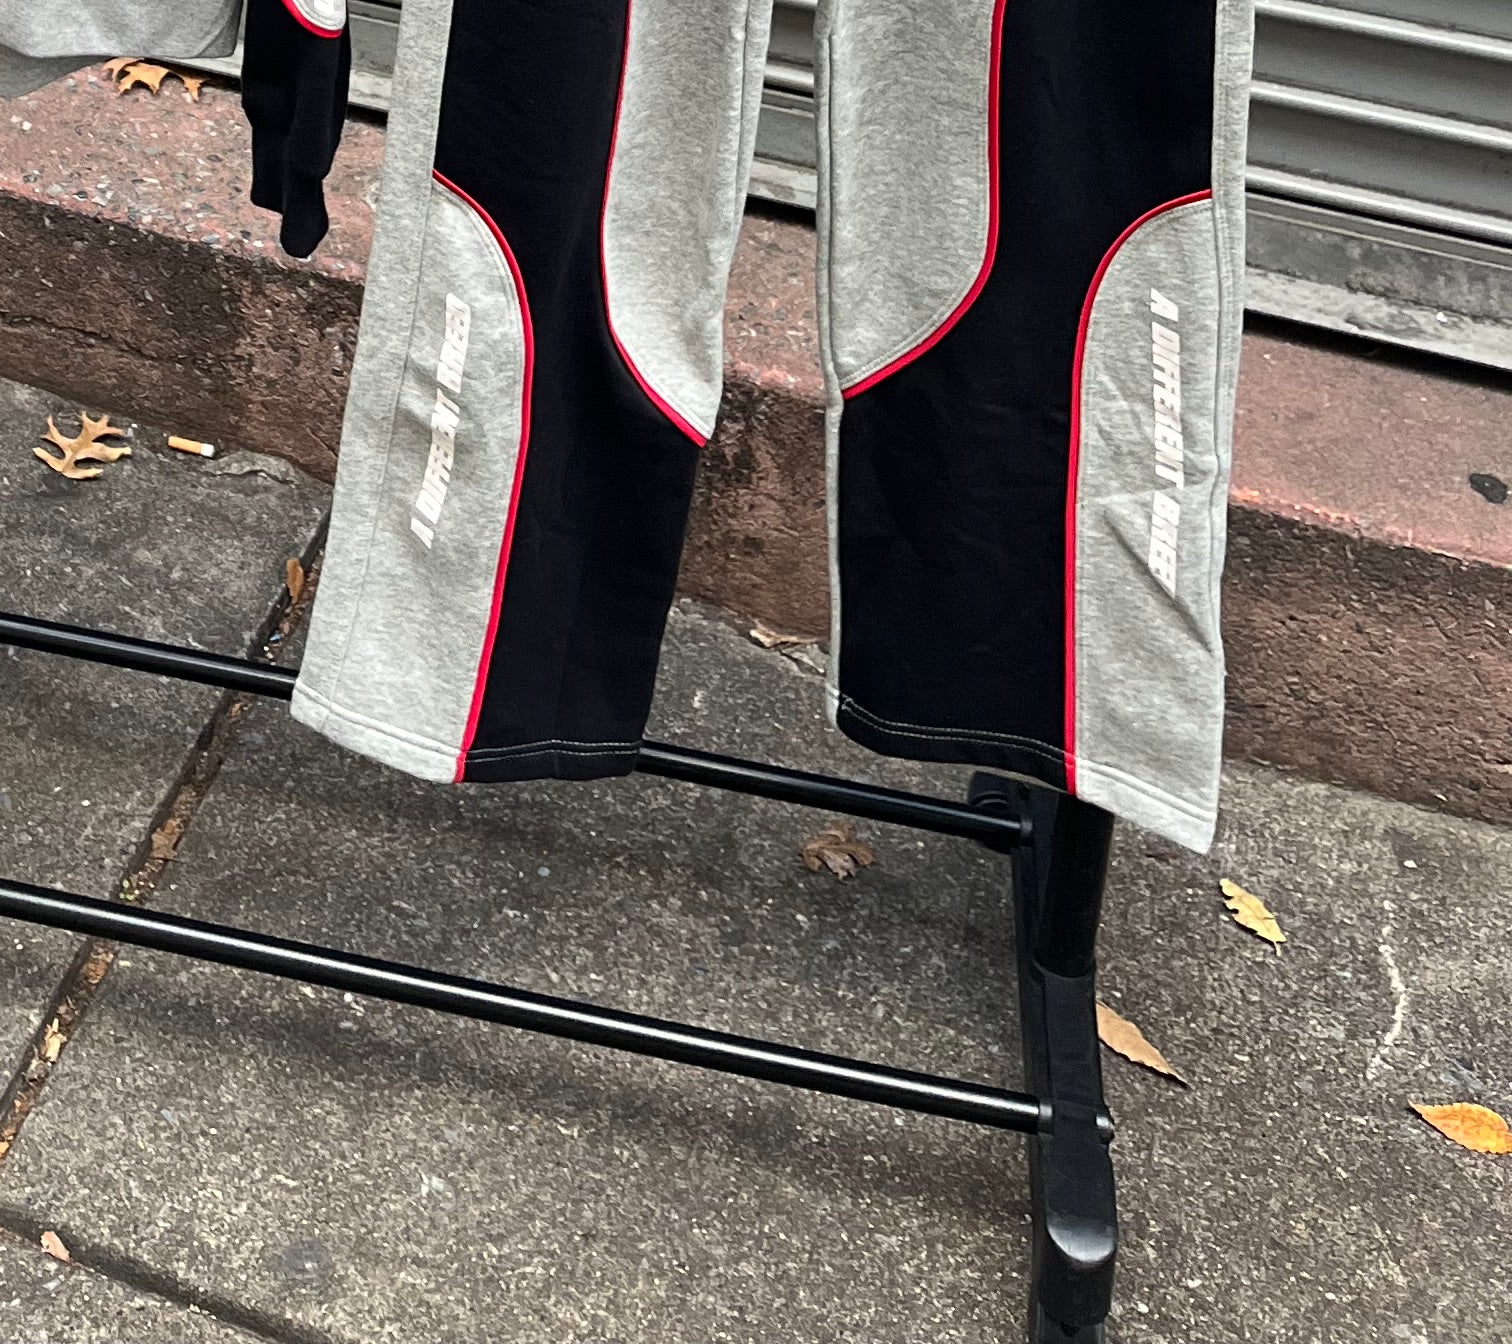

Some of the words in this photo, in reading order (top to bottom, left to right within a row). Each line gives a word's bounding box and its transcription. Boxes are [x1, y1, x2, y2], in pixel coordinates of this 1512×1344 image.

[1150, 287, 1179, 323] A
[1151, 321, 1185, 491] DIFFERENT
[1148, 490, 1180, 598] BREE
